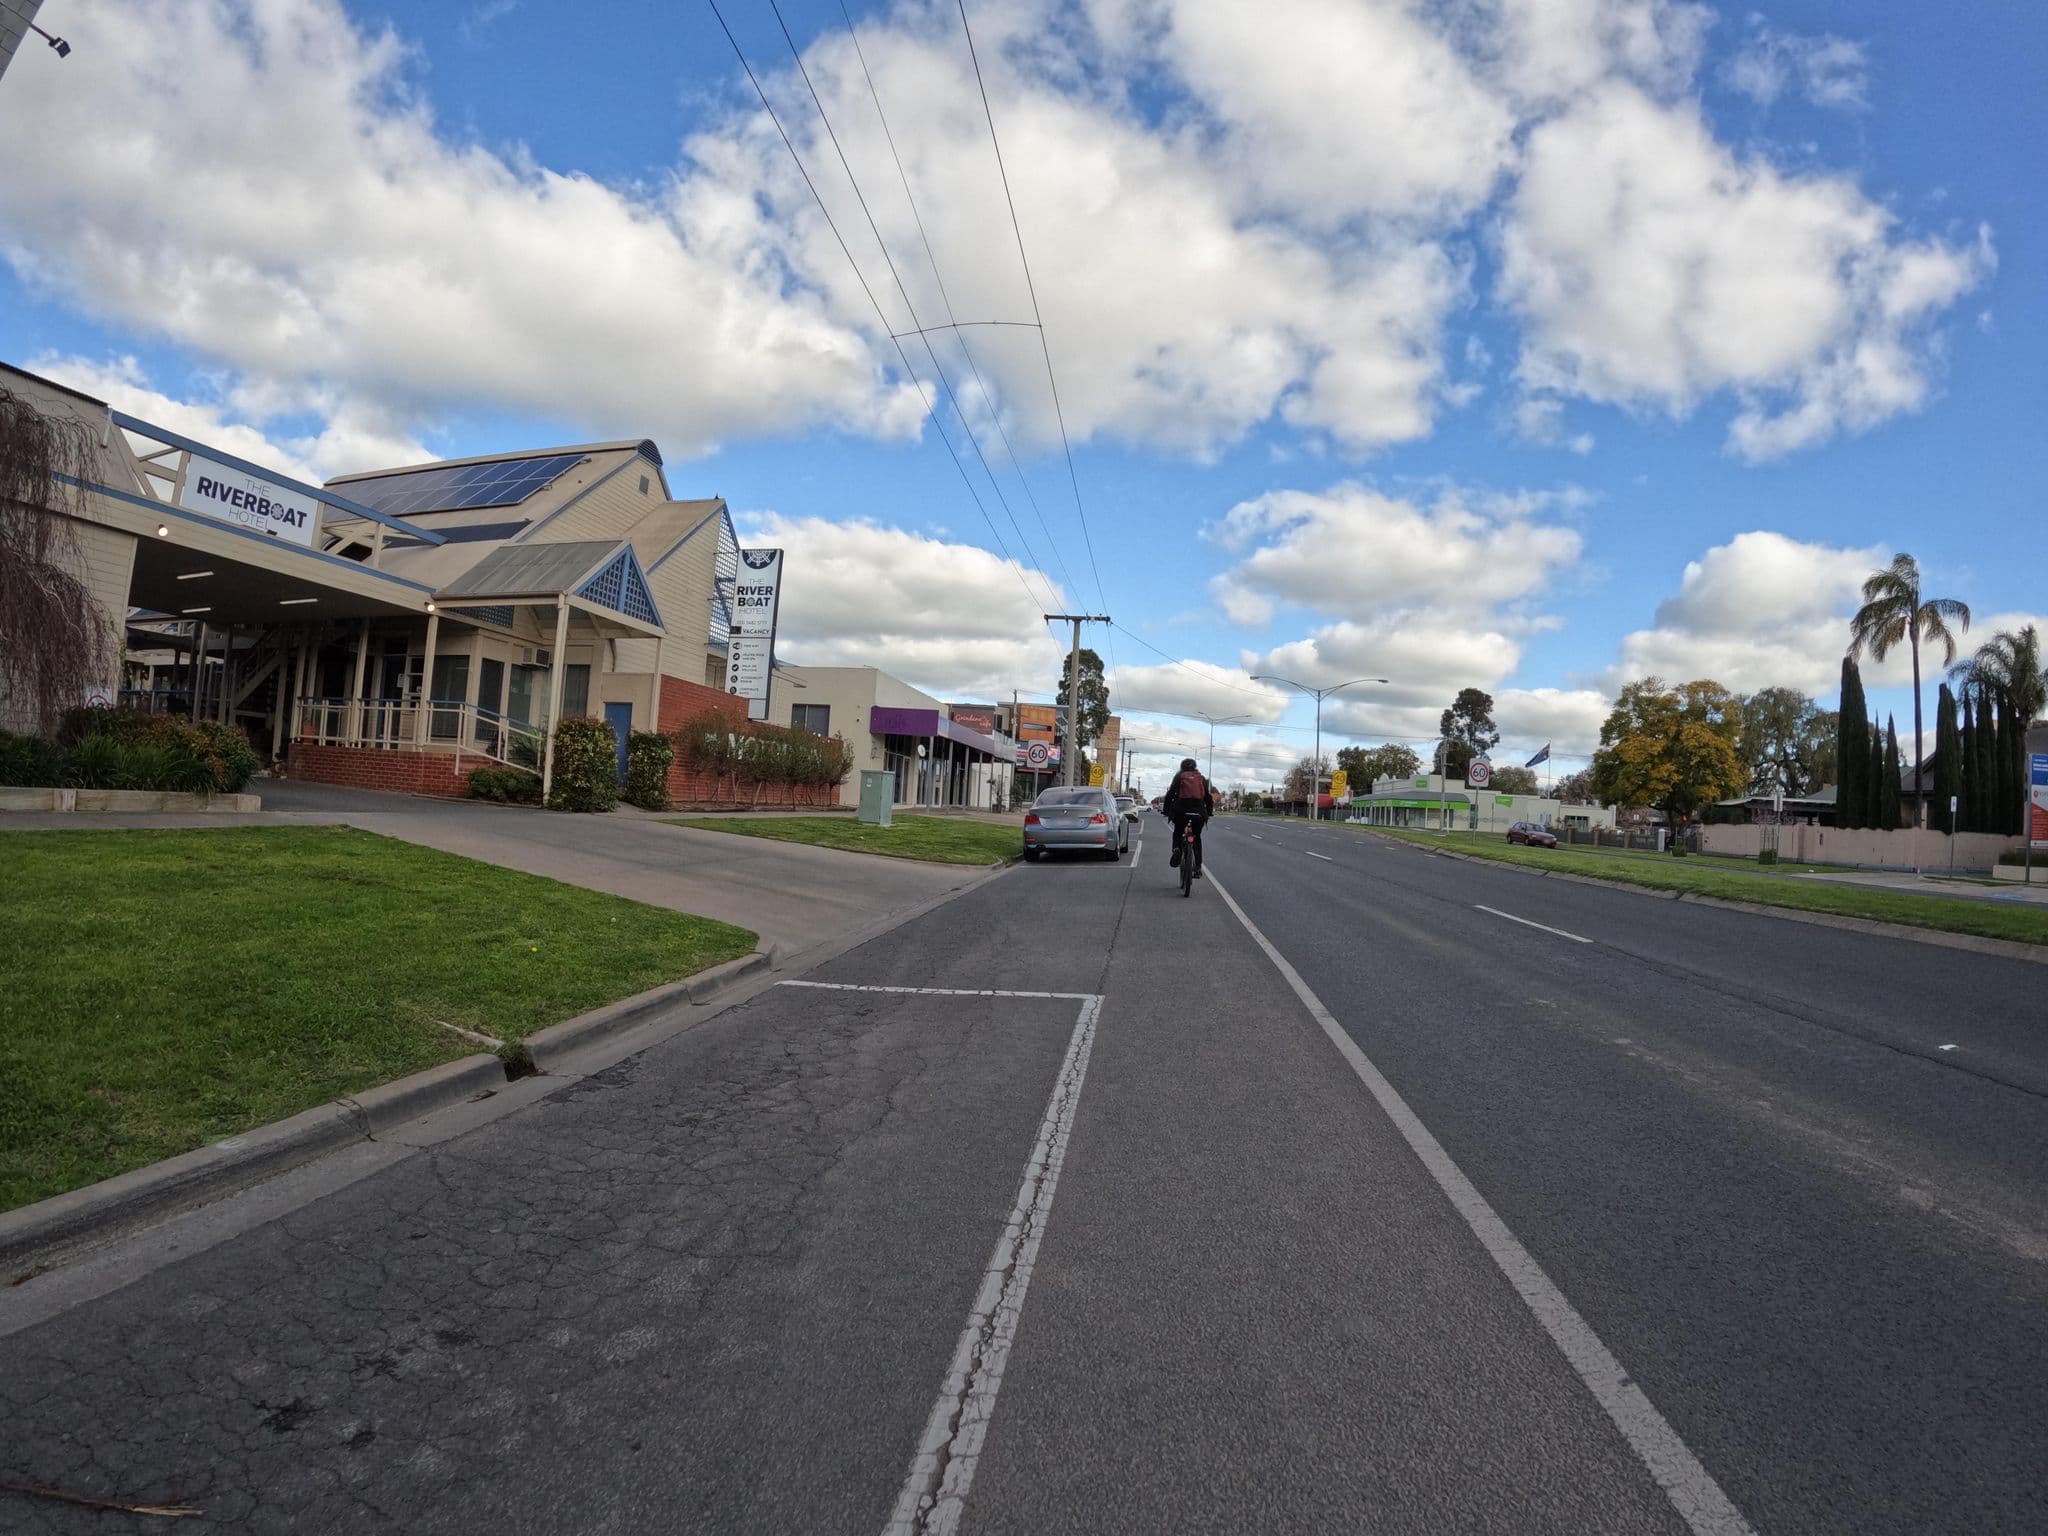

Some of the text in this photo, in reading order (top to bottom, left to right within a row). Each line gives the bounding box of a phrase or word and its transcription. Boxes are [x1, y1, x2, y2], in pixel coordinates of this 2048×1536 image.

[245, 477, 271, 497] THE
[197, 476, 308, 529] RIVERBOAT
[228, 508, 270, 530] HOTEL
[736, 586, 774, 596] RIVER
[737, 597, 771, 607] BOAT
[1031, 749, 1045, 759] 60
[1473, 767, 1486, 778] 60
